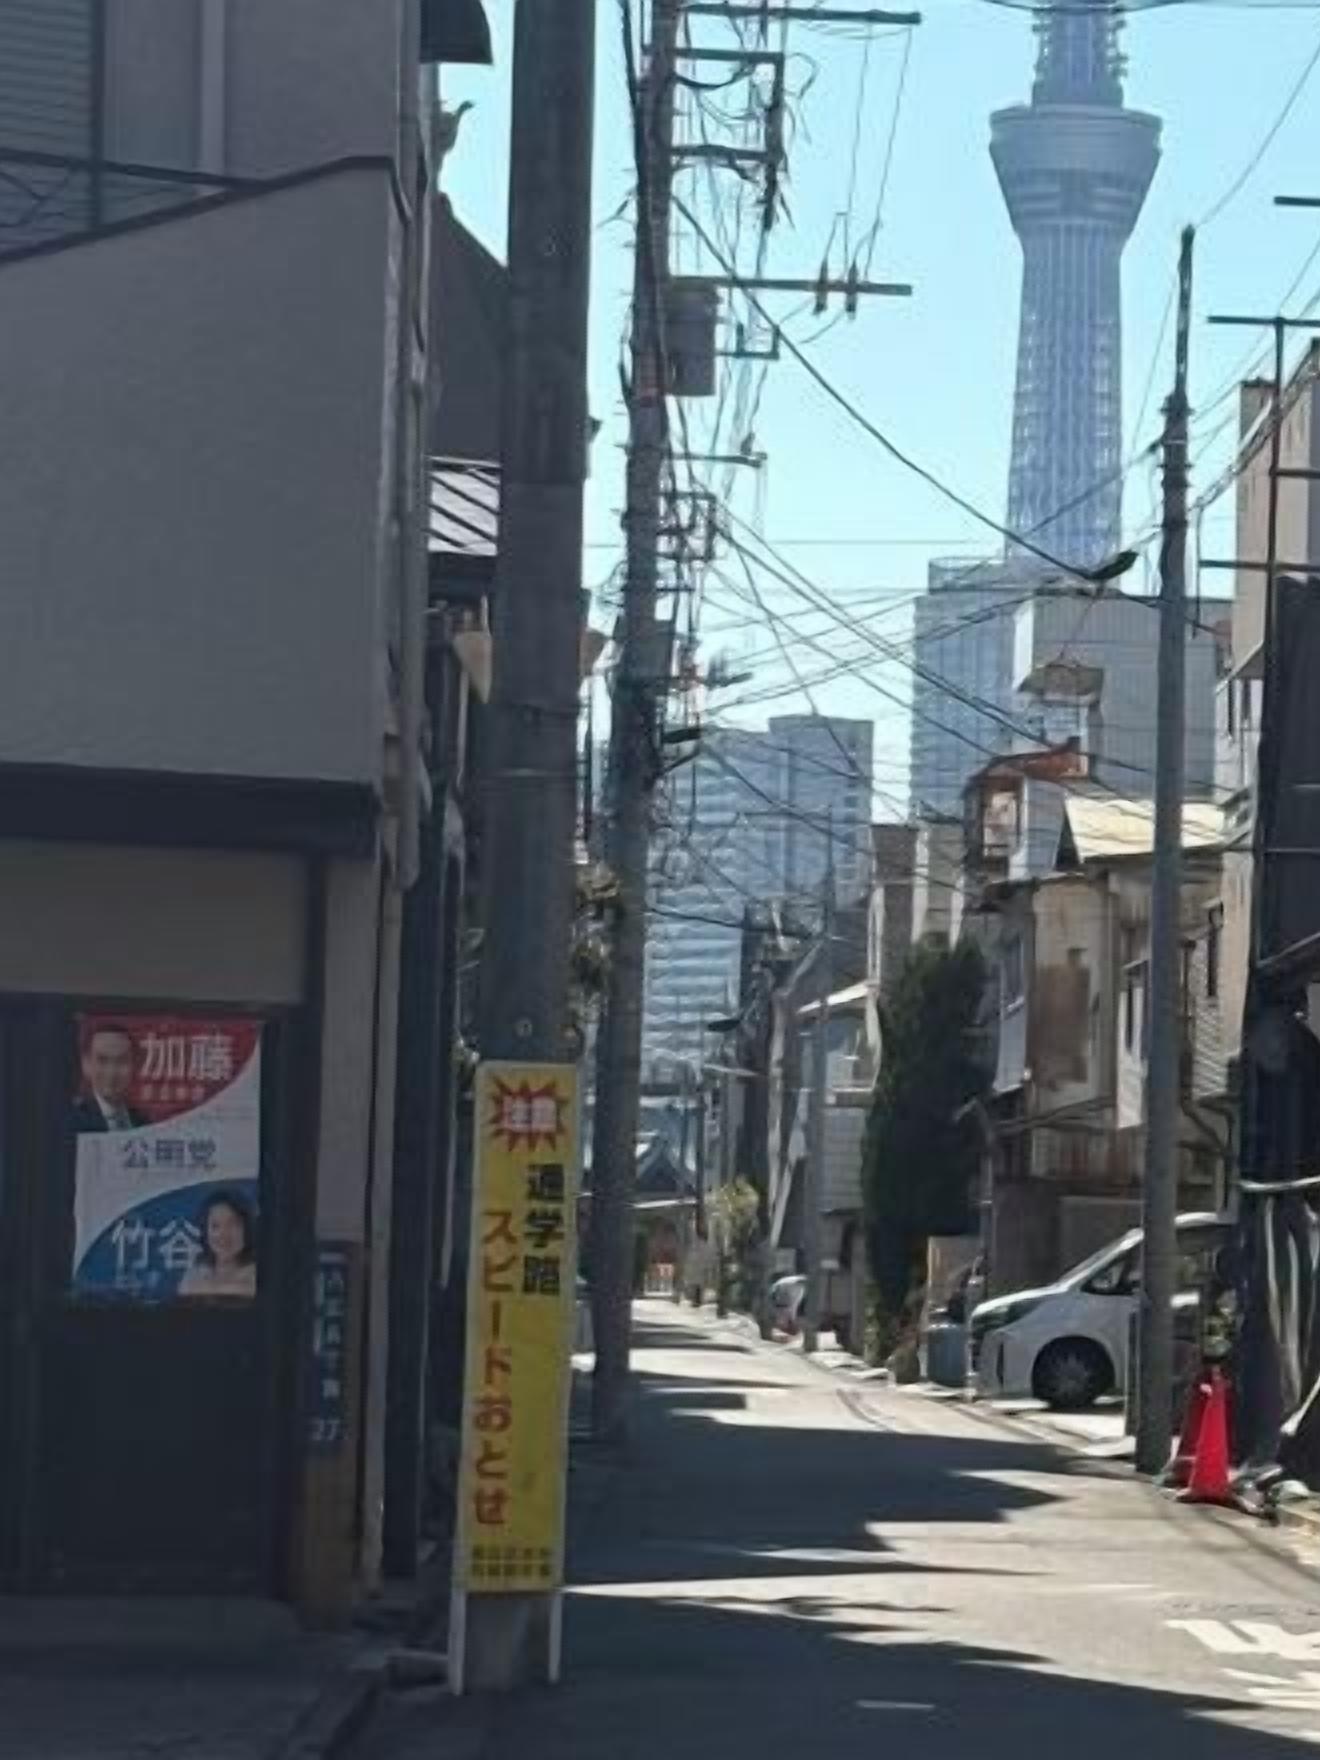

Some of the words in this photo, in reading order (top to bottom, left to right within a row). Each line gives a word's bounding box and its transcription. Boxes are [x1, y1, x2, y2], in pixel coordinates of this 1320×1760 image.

[139, 1033, 234, 1080] 加藤
[124, 1139, 217, 1170] 公明党
[111, 1219, 203, 1269] 竹谷
[523, 1163, 564, 1295] 通学路
[474, 1210, 518, 1525] スピードおとせ
